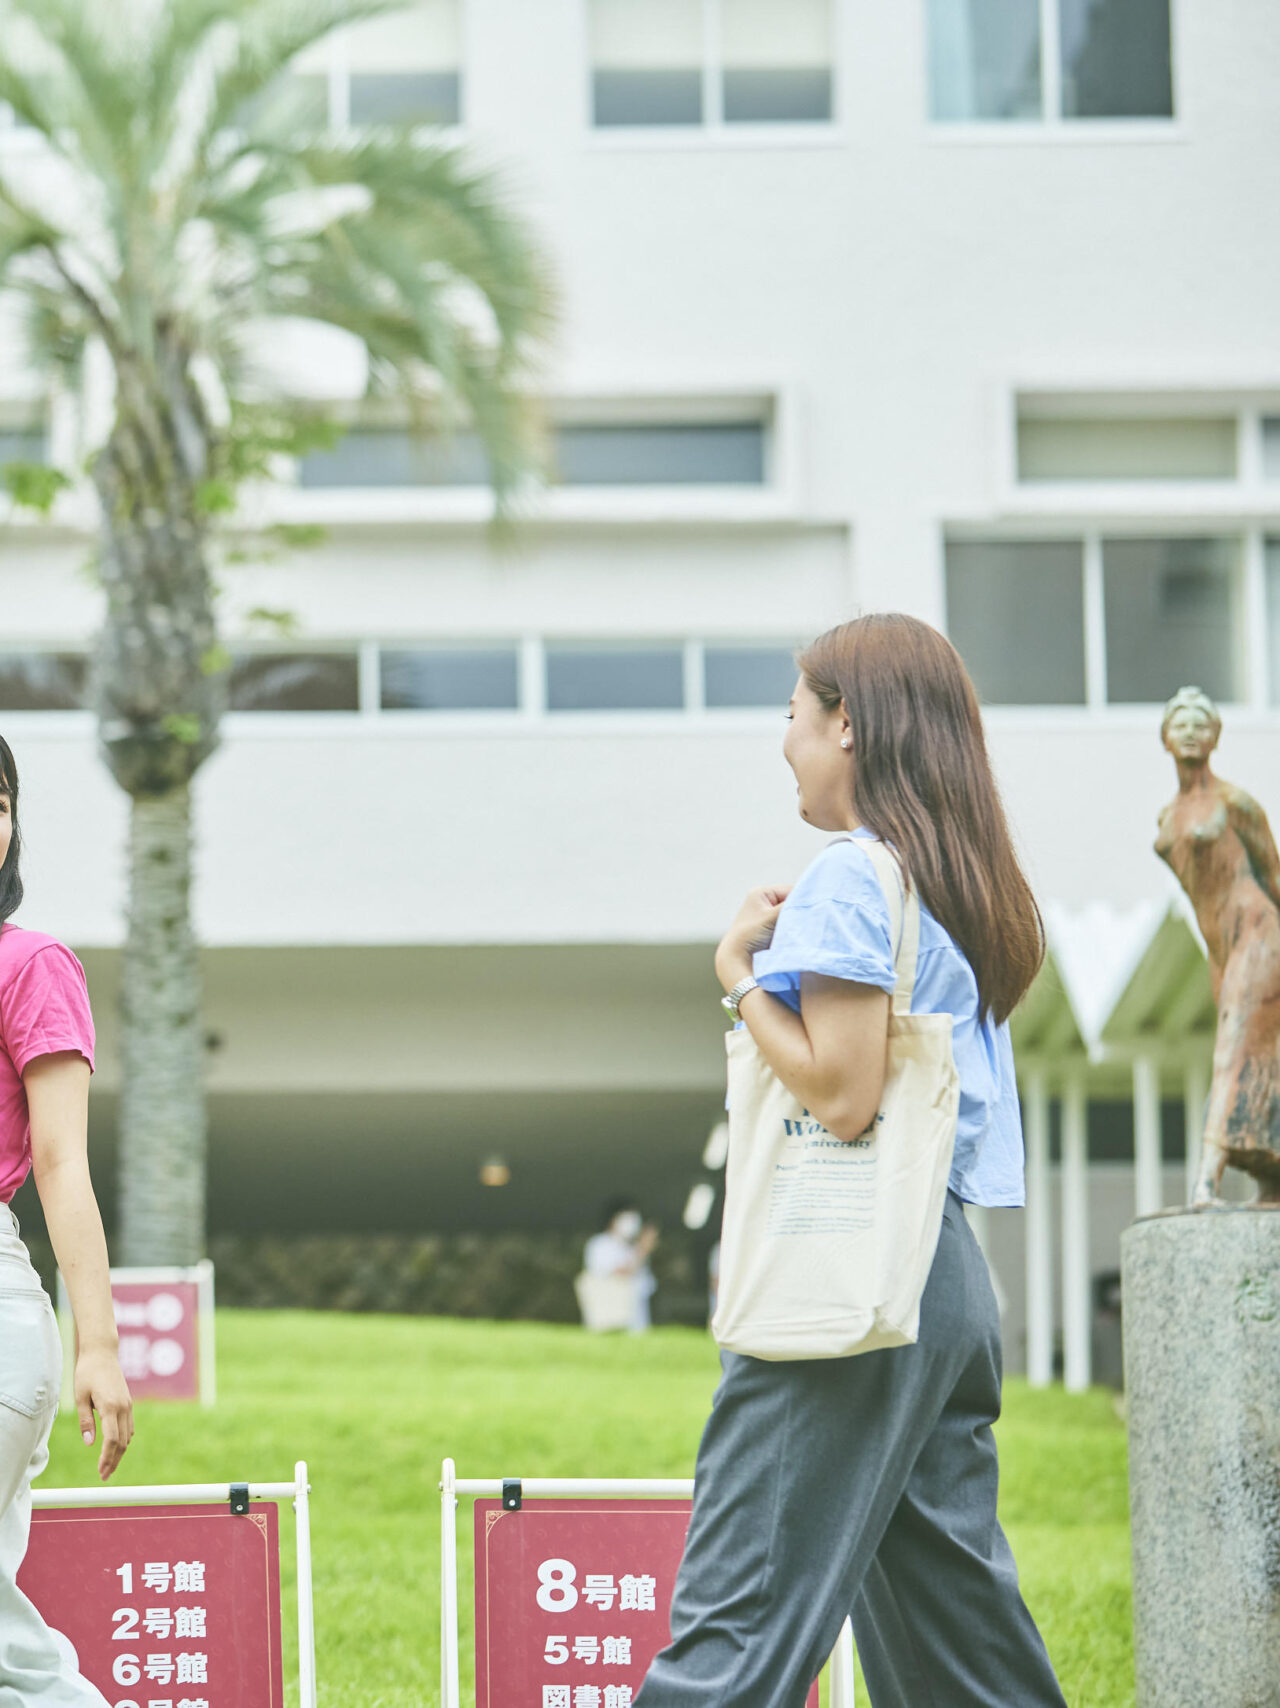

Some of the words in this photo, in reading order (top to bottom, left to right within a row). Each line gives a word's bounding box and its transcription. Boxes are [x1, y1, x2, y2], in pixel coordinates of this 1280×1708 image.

[117, 1561, 205, 1593] 1号館
[536, 1559, 656, 1612] 8号館
[112, 1607, 206, 1639] 2号館
[544, 1636, 631, 1664] 5号館
[113, 1652, 207, 1686] 6号館
